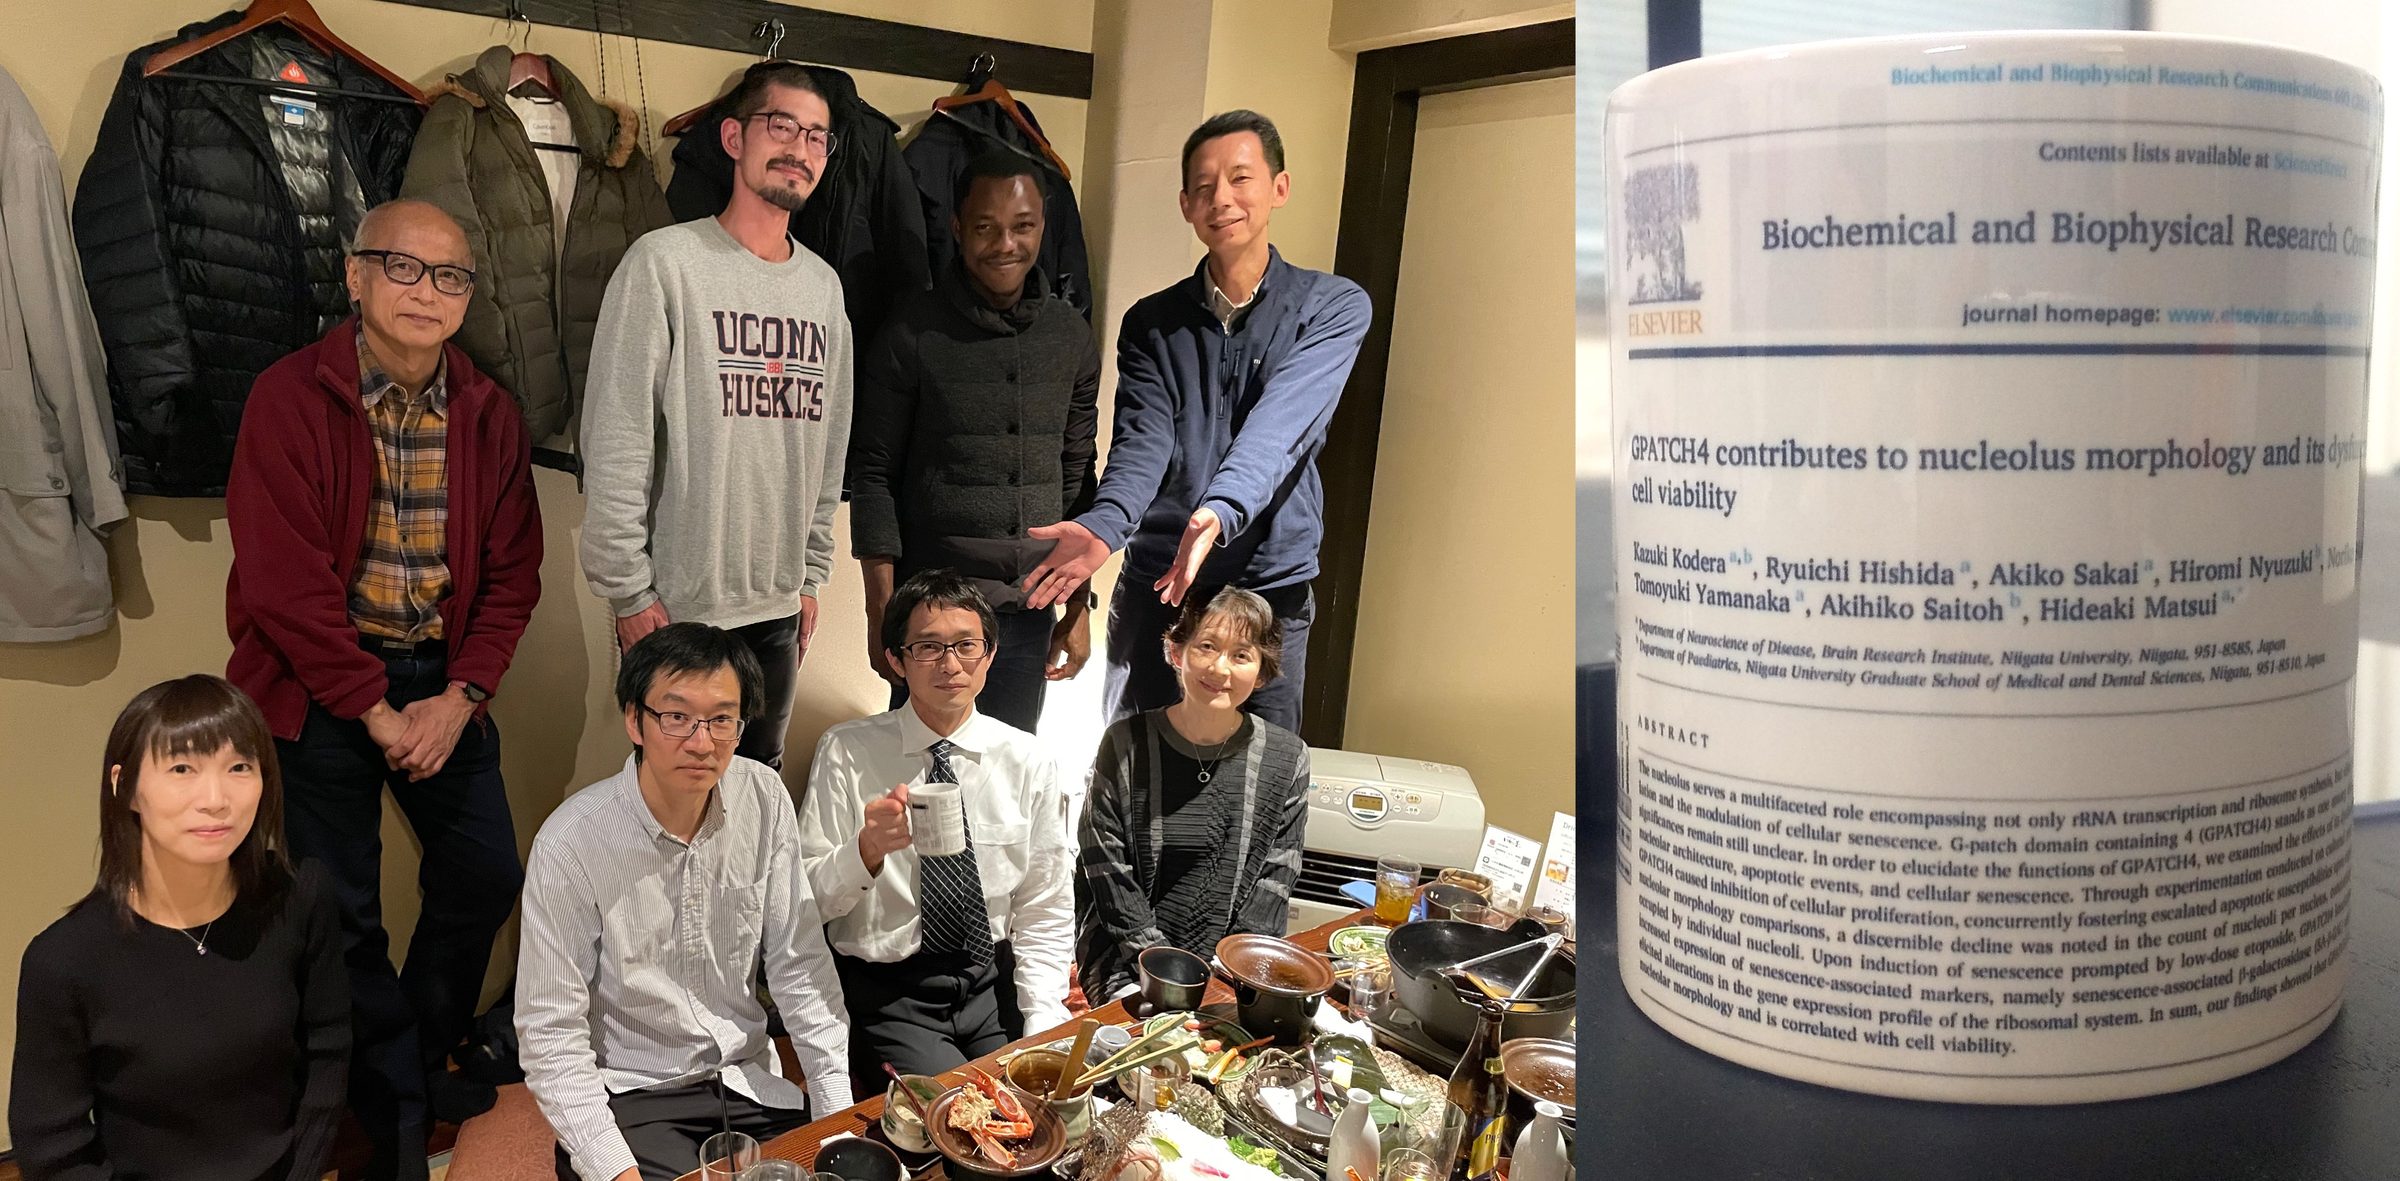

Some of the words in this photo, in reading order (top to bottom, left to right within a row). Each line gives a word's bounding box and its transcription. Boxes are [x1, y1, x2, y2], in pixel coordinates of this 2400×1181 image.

[1892, 64, 2002, 85] Biochemical
[2010, 65, 2043, 82] and
[2052, 63, 2152, 86] Biophysical
[2158, 67, 2228, 88] Research
[2039, 142, 2126, 162] Contents
[2133, 142, 2170, 162] lists
[2175, 145, 2251, 166] available
[2255, 152, 2269, 169] at
[1762, 212, 1957, 250] Biochemical
[1972, 211, 2035, 243] and
[2051, 210, 2234, 251] Biophysical
[2245, 216, 2337, 254] Research
[712, 311, 827, 366] UCONN
[1629, 310, 1702, 336] ELSEVIER
[1962, 303, 2037, 327] journal
[2046, 305, 2160, 326] homepage:
[1631, 435, 1709, 465] GPATCH4
[1716, 439, 1867, 469] contributes
[1878, 444, 1908, 470] to
[1918, 440, 2075, 470] nucleolus
[2086, 439, 2256, 477] morphology
[2262, 437, 2301, 466] and
[2306, 435, 2325, 463] its
[1632, 477, 1652, 503] cell
[1658, 479, 1737, 517] viability
[1634, 541, 1667, 566] Kazuki
[1673, 548, 1725, 573] Kodera
[1766, 556, 1849, 584] Ryuichi
[1860, 561, 1954, 585] Hishida
[1989, 562, 2064, 586] Akiko
[2074, 561, 2139, 586] Sakai
[2170, 557, 2242, 582] Hiromi
[2250, 550, 2313, 582] Nyuzuki
[1634, 572, 1690, 602] Tomoyuki
[1697, 584, 1790, 613] Yamanaka
[1821, 594, 1914, 620] Akihiko
[1924, 597, 2004, 621] Saitoh
[2040, 597, 2135, 621] Hideaki
[2144, 593, 2217, 618] Matsui
[1688, 630, 1748, 651] Neuroscience
[1746, 660, 1787, 678] Niigata
[1792, 665, 1856, 686] University
[1861, 670, 1926, 687] Graduate
[1986, 674, 2002, 691] of
[1652, 768, 1690, 791] nucleolus
[1693, 782, 1725, 800] serves
[1730, 791, 1736, 803] a
[1741, 792, 1826, 817] multifaceted
[1833, 804, 1863, 820] role
[1869, 809, 1986, 831] encompassing
[1994, 814, 2020, 828] not
[2028, 812, 2065, 831] only
[2072, 810, 2116, 826] rRNA
[2123, 802, 2217, 825] transcription
[2222, 796, 2245, 815] and
[1659, 793, 1674, 809] and
[1677, 798, 1692, 815] the
[1696, 805, 1761, 832] modulation
[1767, 819, 1782, 834] of
[1786, 823, 1842, 844] cellular
[1849, 832, 1942, 851] senescence.
[1951, 836, 2016, 855] G-patch
[2025, 837, 2088, 853] domain
[2096, 832, 2178, 850] containing
[2185, 829, 2192, 844] 4
[2200, 816, 2272, 844] (GPATCH4)
[1673, 844, 1737, 875] architecture,
[1741, 864, 1805, 887] apoptotic
[1810, 878, 1864, 898] events,
[1870, 882, 1900, 899] and
[1907, 885, 1970, 902] cellular
[1976, 890, 2073, 904] senescence.
[2082, 883, 2148, 903] Through
[2155, 868, 2262, 898] experimentation
[1688, 827, 1723, 847] remain
[1726, 837, 1749, 853] still
[1753, 843, 1807, 863] unclear.
[1813, 850, 1828, 866] In
[1832, 854, 1875, 871] order
[1881, 859, 1896, 873] to
[1902, 859, 1979, 878] elucidate
[1985, 862, 2011, 878] the
[2019, 862, 2095, 878] functions
[2100, 860, 2118, 875] of
[2121, 853, 2200, 874] GPATCH4,
[2206, 852, 2224, 865] we
[2228, 836, 2282, 862] examined
[1639, 847, 1673, 876] GPATCH4
[1675, 866, 1707, 890] caused
[1710, 878, 1768, 905] inhibition
[1773, 893, 1789, 908] of
[1790, 896, 1846, 918] cellular
[1851, 906, 1959, 928] proliferation,
[1964, 912, 2072, 932] concurrently
[2078, 910, 2147, 927] fostering
[2151, 898, 2216, 922] escalated
[2220, 888, 2275, 915] apoptotic
[1672, 909, 1683, 929] by
[1687, 916, 1741, 946] individual
[1747, 936, 1804, 960] nucleoli.
[1812, 948, 1852, 968] Upon
[1861, 954, 1938, 977] induction
[1947, 961, 1965, 978] of
[1972, 965, 2064, 980] senescence
[2071, 957, 2149, 982] prompted
[2157, 956, 2174, 974] by
[2180, 946, 2240, 969] low-dose
[1674, 890, 1734, 922] morphology
[1740, 912, 1830, 942] comparisons,
[1837, 931, 1846, 942] a
[1853, 929, 1943, 951] discernible
[1951, 937, 2013, 954] decline
[2022, 941, 2053, 954] was
[2062, 935, 2107, 954] noted
[2115, 935, 2129, 950] in
[2137, 932, 2162, 949] the
[2167, 927, 2206, 946] count
[2214, 922, 2228, 938] of
[2232, 910, 2276, 936] nucleoli
[2281, 907, 2296, 925] per
[1665, 954, 1714, 986] alterations
[1718, 975, 1729, 991] in
[1734, 980, 1752, 998] the
[1757, 989, 1788, 1006] gene
[1792, 999, 1872, 1020] expression
[1879, 1009, 1932, 1027] profile
[1939, 1013, 1958, 1028] of
[1963, 1014, 1989, 1029] the
[1995, 1013, 2078, 1031] ribosomal
[2085, 1013, 2143, 1031] system.
[2150, 1007, 2163, 1022] In
[2207, 997, 2230, 1013] our
[1674, 934, 1725, 966] expression
[1732, 956, 1744, 972] of
[1748, 961, 1912, 1000] senescence-associated
[1921, 986, 1994, 1005] markers,
[2003, 988, 2064, 1008] namely
[2072, 969, 2232, 1004] senescence-associated
[1674, 981, 1734, 1018] morphology
[1738, 1006, 1761, 1023] and
[1767, 1011, 1777, 1026] is
[1782, 1017, 1856, 1042] correlated
[1864, 1031, 1899, 1048] with
[1906, 1035, 1934, 1050] cell
[1943, 1036, 2016, 1057] viability.
